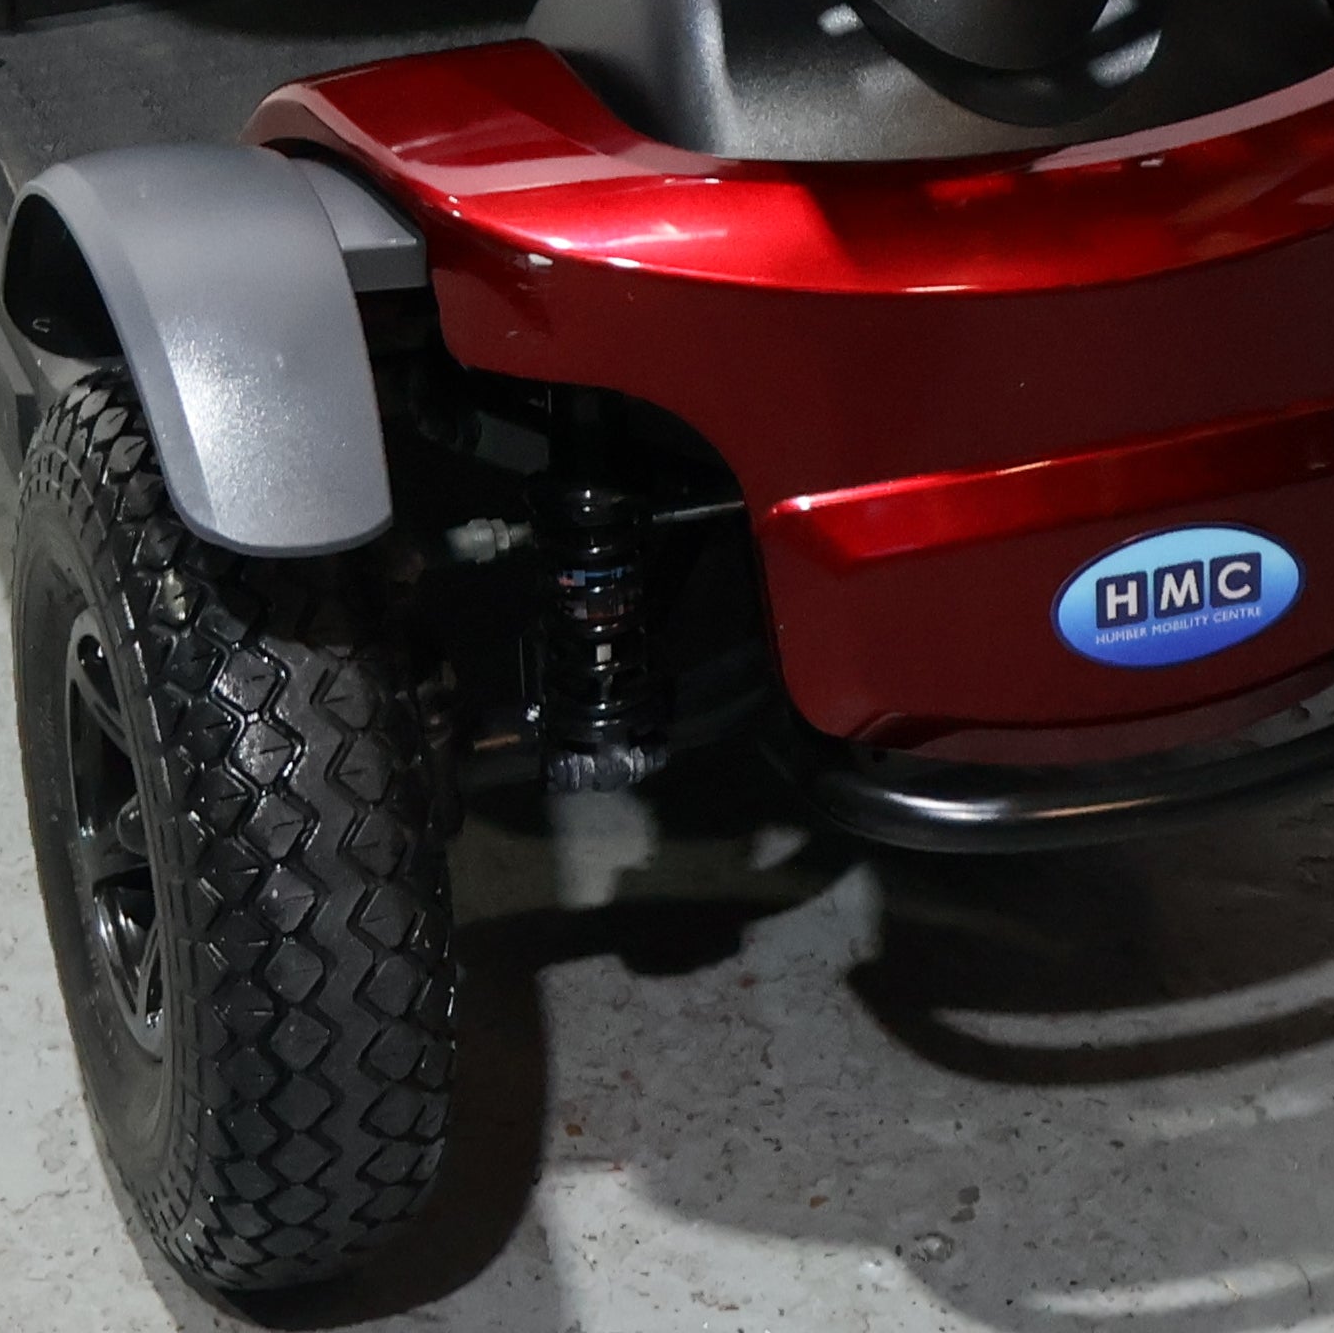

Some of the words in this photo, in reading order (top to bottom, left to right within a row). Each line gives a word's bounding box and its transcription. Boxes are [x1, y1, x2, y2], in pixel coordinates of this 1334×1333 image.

[1104, 559, 1254, 623] HMC
[1095, 626, 1148, 645] HUMBER
[1151, 614, 1209, 637] MOBILITY
[1212, 605, 1263, 624] CENTRE
